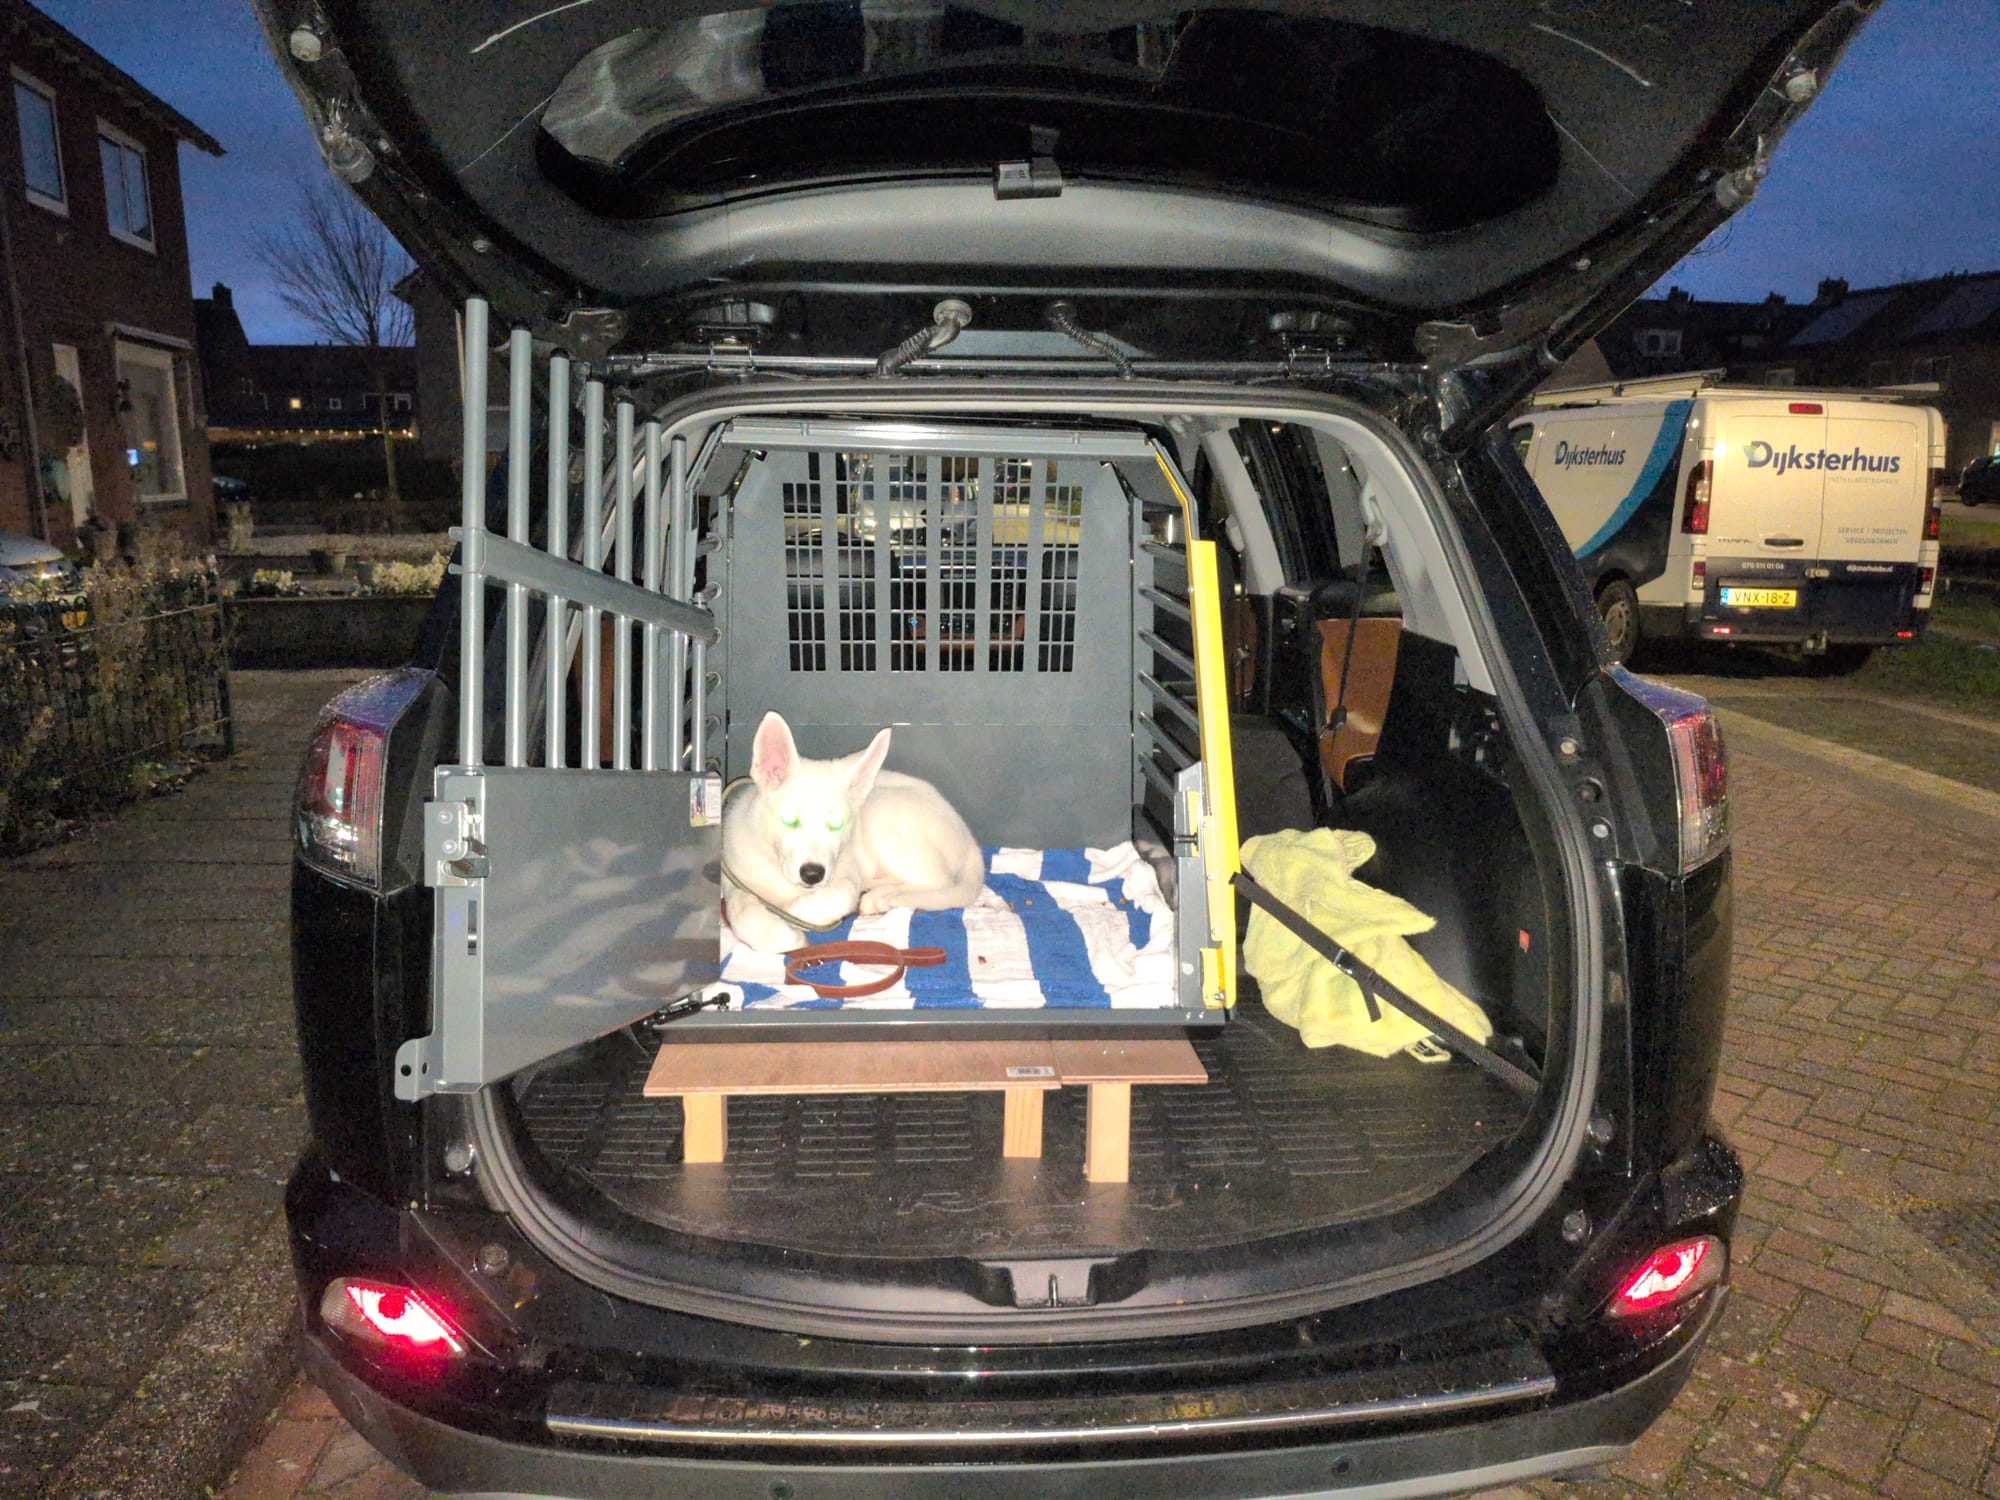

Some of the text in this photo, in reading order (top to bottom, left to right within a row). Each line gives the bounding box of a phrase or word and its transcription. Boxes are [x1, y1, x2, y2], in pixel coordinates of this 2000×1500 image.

[1554, 441, 1626, 471] Dijksterhuis
[1745, 440, 1900, 476] Dijksterhuis
[1838, 527, 1865, 535] SERVICE
[1741, 561, 1755, 569] 070
[1734, 591, 1790, 604] VNX-18-Z
